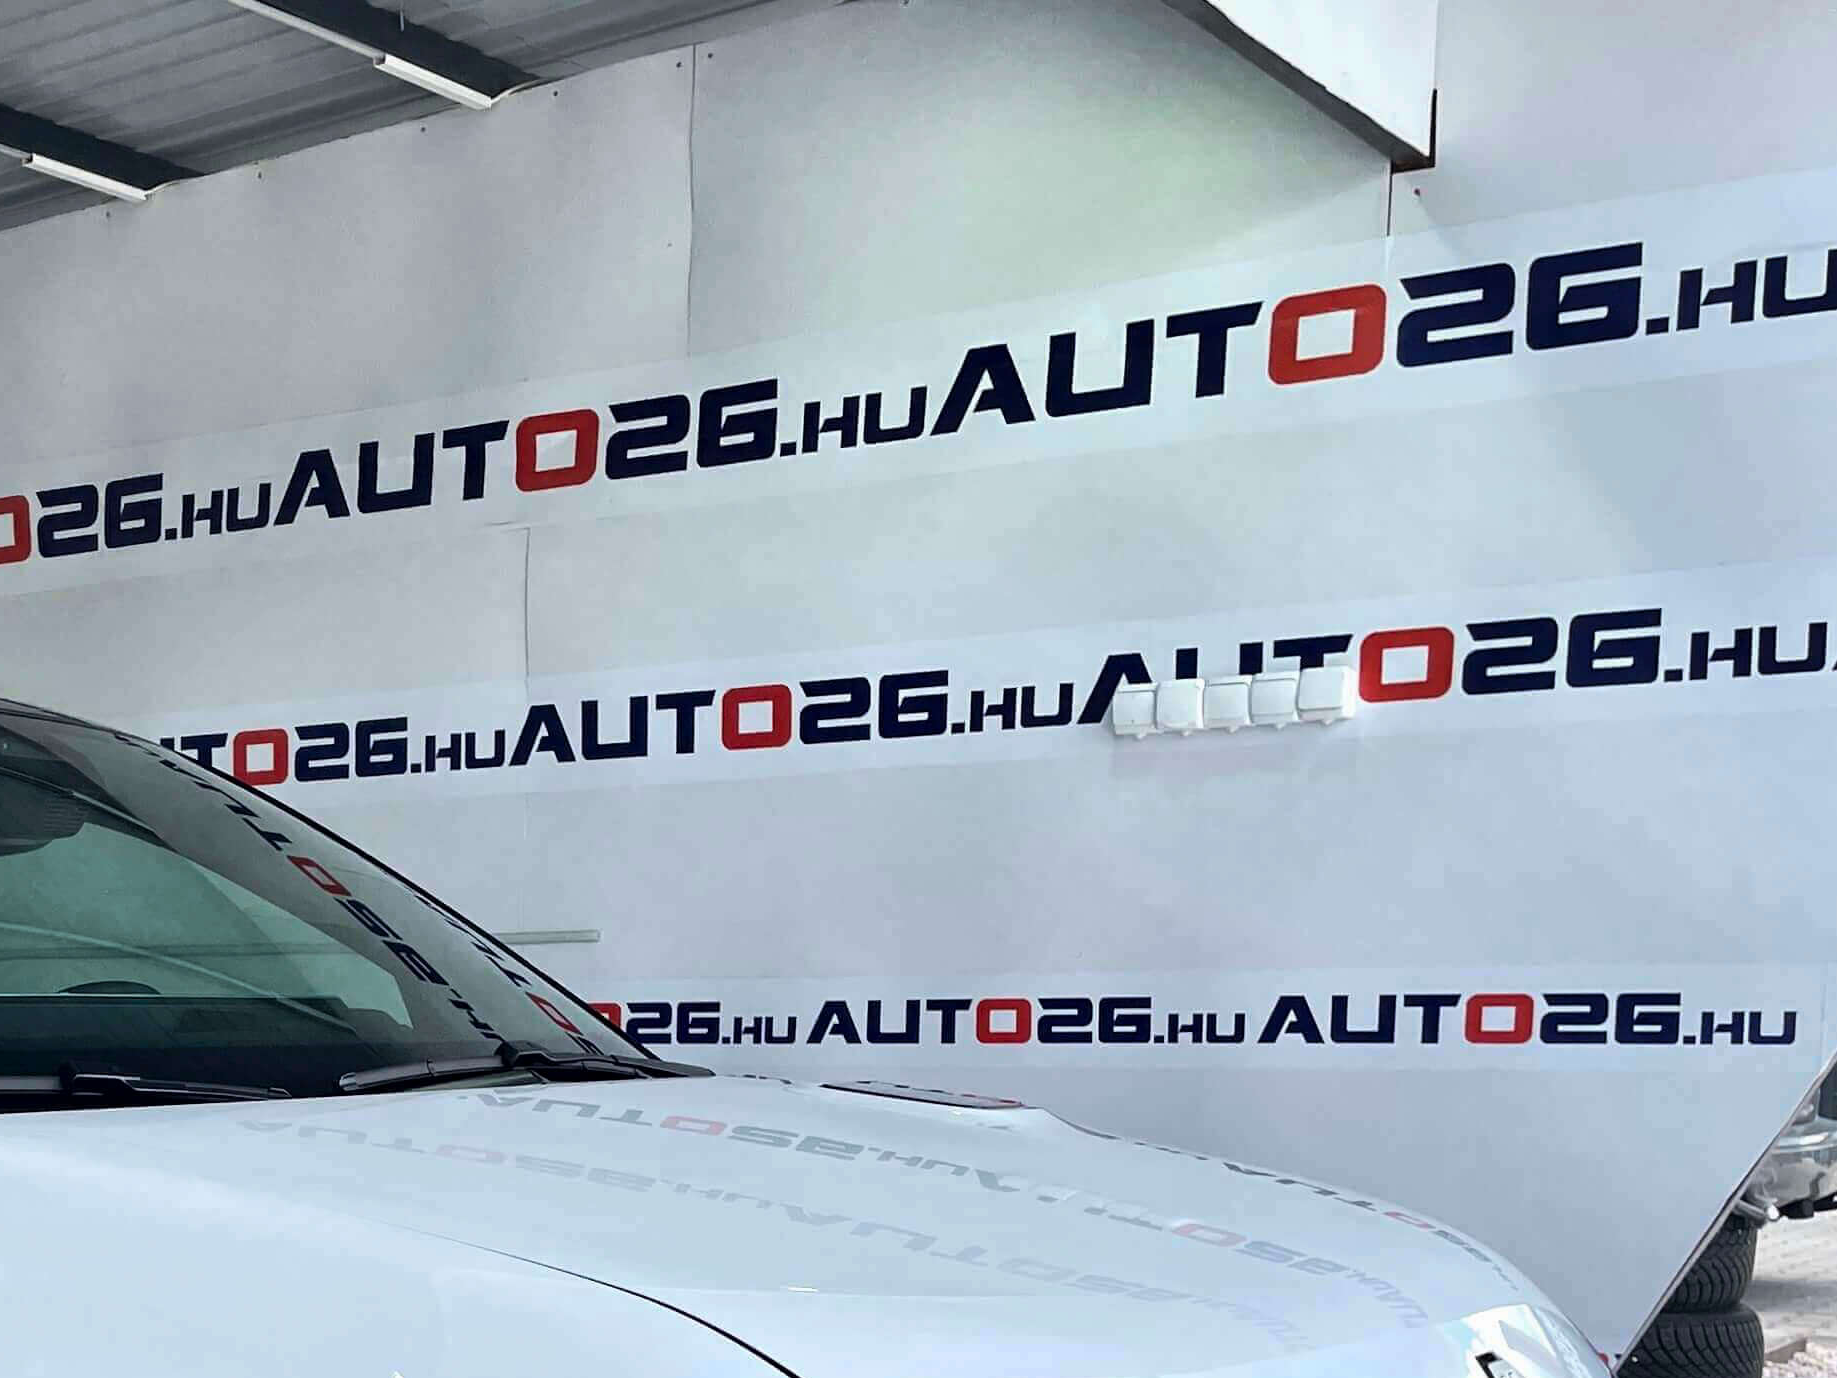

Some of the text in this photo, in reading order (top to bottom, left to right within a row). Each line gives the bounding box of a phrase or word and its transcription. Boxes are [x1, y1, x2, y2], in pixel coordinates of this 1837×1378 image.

[272, 378, 928, 527] AUTO26.HU
[929, 242, 1837, 437] AUTO26.HU
[508, 669, 1074, 767] AUTO26.HU
[806, 997, 1246, 1045] AUTO26.HU
[1258, 992, 1797, 1045] AUTO26.HU
